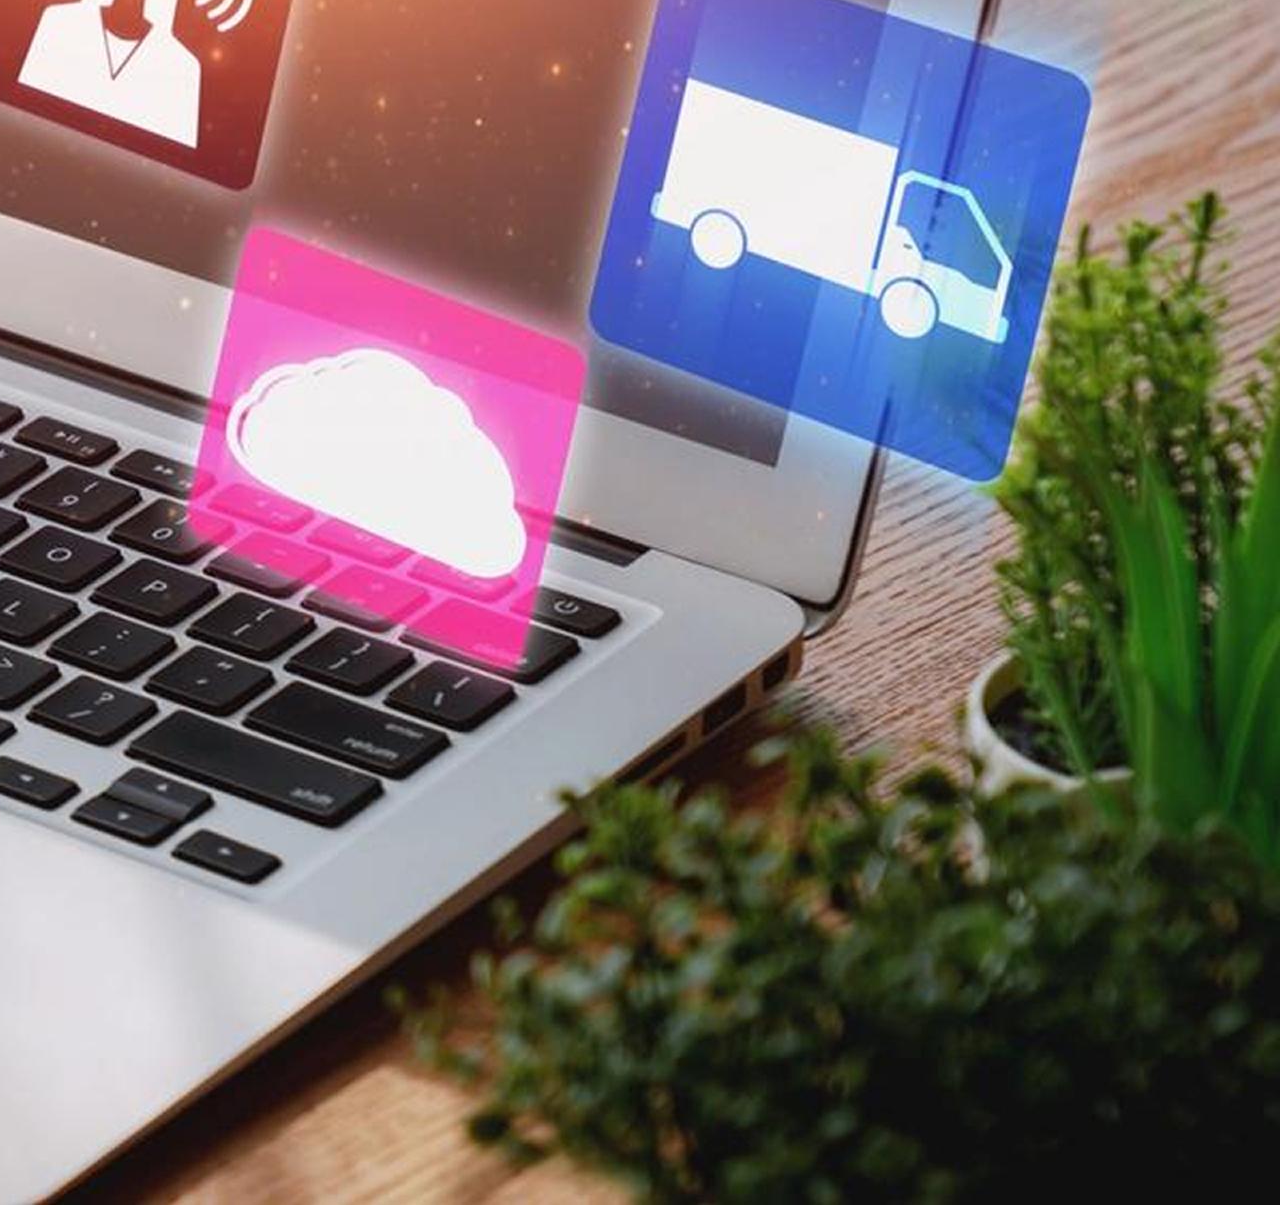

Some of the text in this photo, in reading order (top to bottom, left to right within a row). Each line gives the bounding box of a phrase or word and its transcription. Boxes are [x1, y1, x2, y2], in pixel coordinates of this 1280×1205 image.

[59, 494, 80, 506] 9
[46, 547, 73, 562] O
[141, 579, 168, 593] P
[2, 600, 21, 616] L
